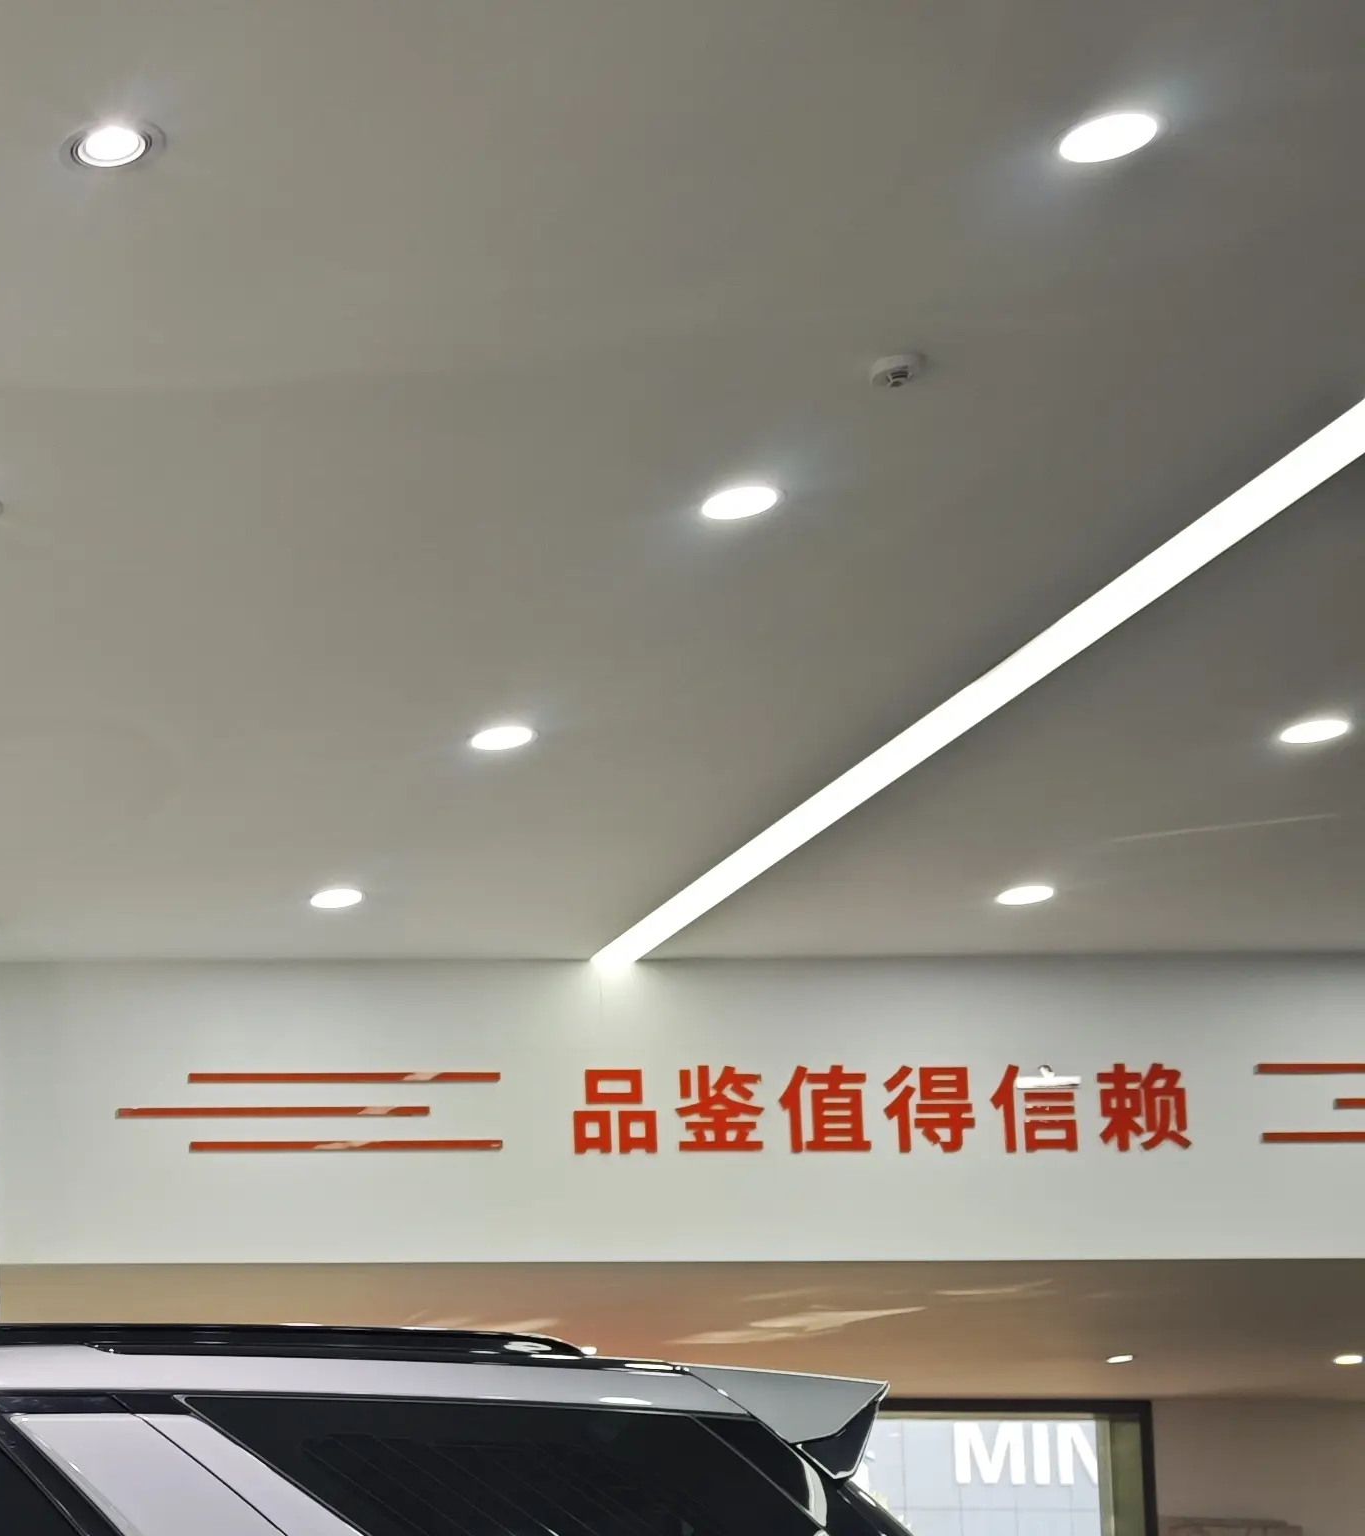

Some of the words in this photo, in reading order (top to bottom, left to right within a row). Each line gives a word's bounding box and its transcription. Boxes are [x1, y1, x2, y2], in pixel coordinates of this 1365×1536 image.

[572, 1062, 1192, 1155] 品鉴值得信赖
